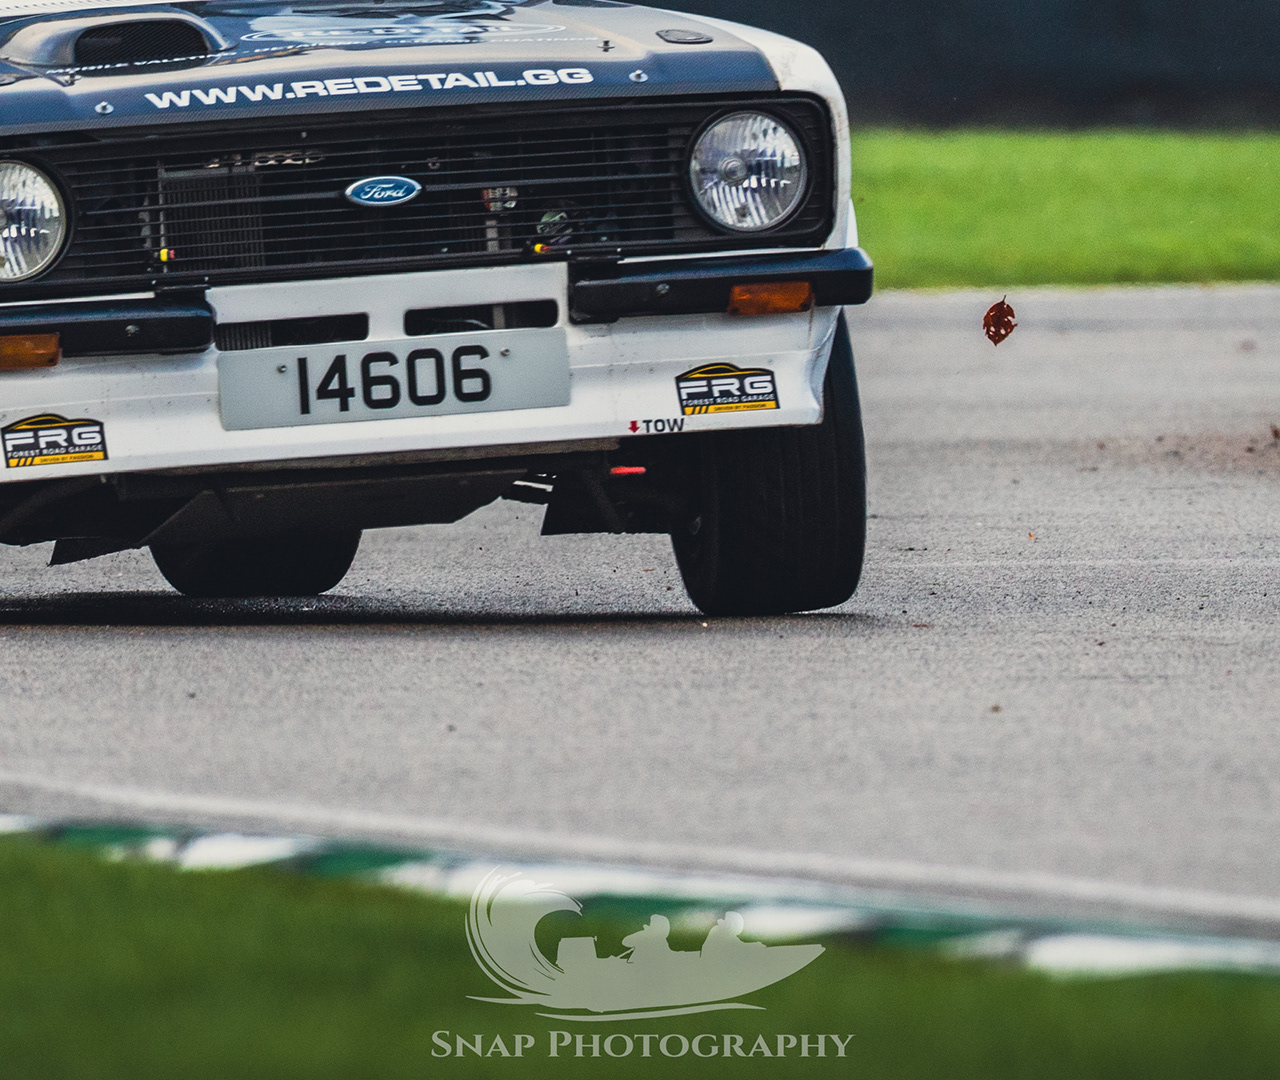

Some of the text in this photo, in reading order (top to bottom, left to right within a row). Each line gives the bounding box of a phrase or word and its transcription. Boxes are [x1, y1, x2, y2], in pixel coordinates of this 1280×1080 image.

[145, 67, 594, 109] WWW.REDETAIL.GG
[360, 183, 408, 200] Ford
[298, 343, 492, 416] 14606
[678, 374, 774, 400] FRG
[682, 393, 775, 407] FOREST ROAD GARAGE
[642, 417, 685, 434] TOW
[4, 425, 102, 452] FRG
[7, 444, 103, 459] FOREST ROAD GARAGE
